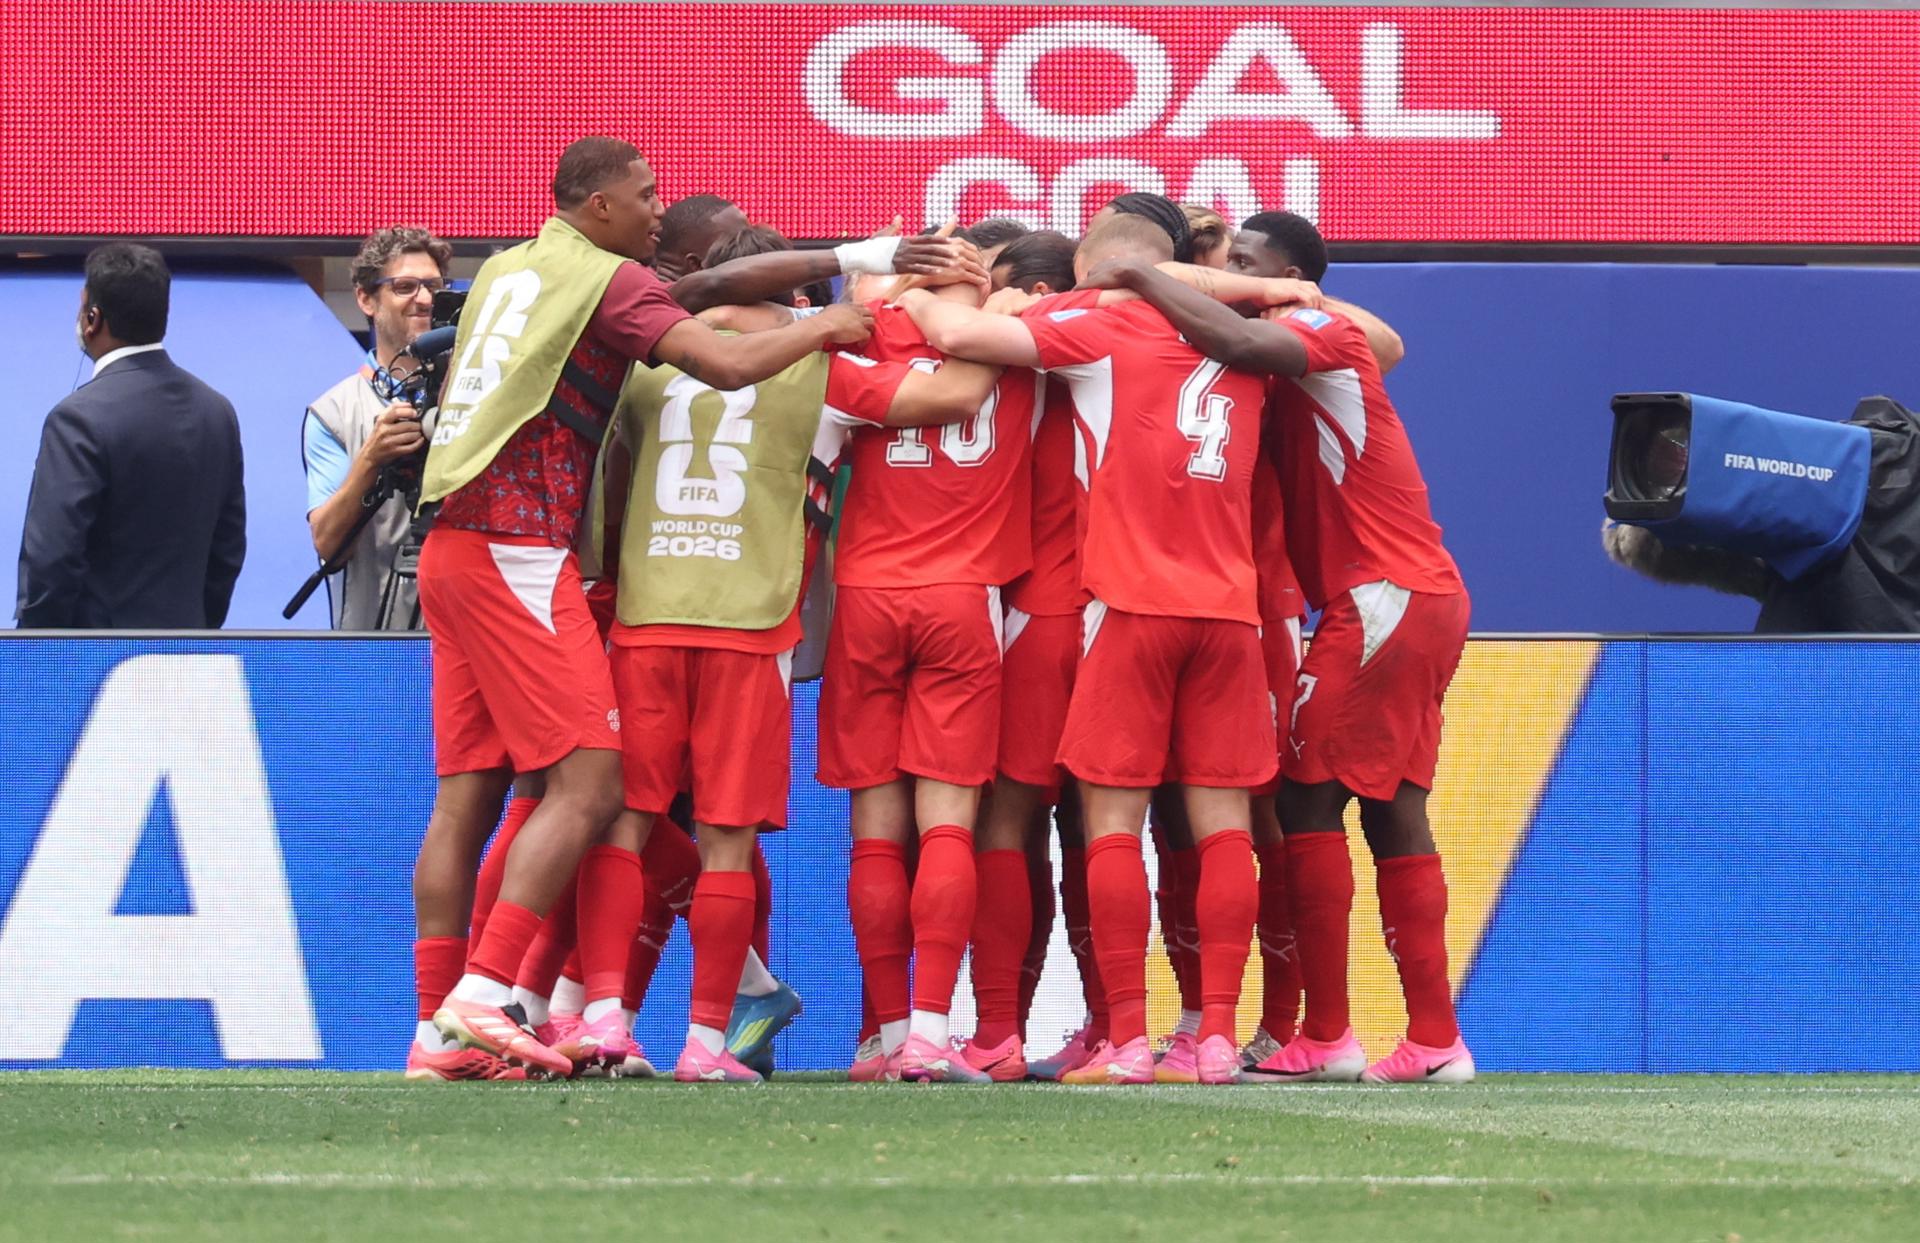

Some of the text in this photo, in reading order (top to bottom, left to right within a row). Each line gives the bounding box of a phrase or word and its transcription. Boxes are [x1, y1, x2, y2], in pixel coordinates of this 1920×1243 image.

[805, 19, 1501, 141] GOAL
[456, 375, 484, 392] FIFA
[431, 418, 472, 447] 20
[1176, 357, 1235, 482] 4
[1724, 453, 1833, 482] FIFA WORLD CUP
[678, 486, 720, 503] FIFA
[651, 520, 744, 538] WORLD CUP
[647, 535, 742, 561] 2026
[1291, 672, 1319, 730] 7
[0, 653, 325, 1060] A
